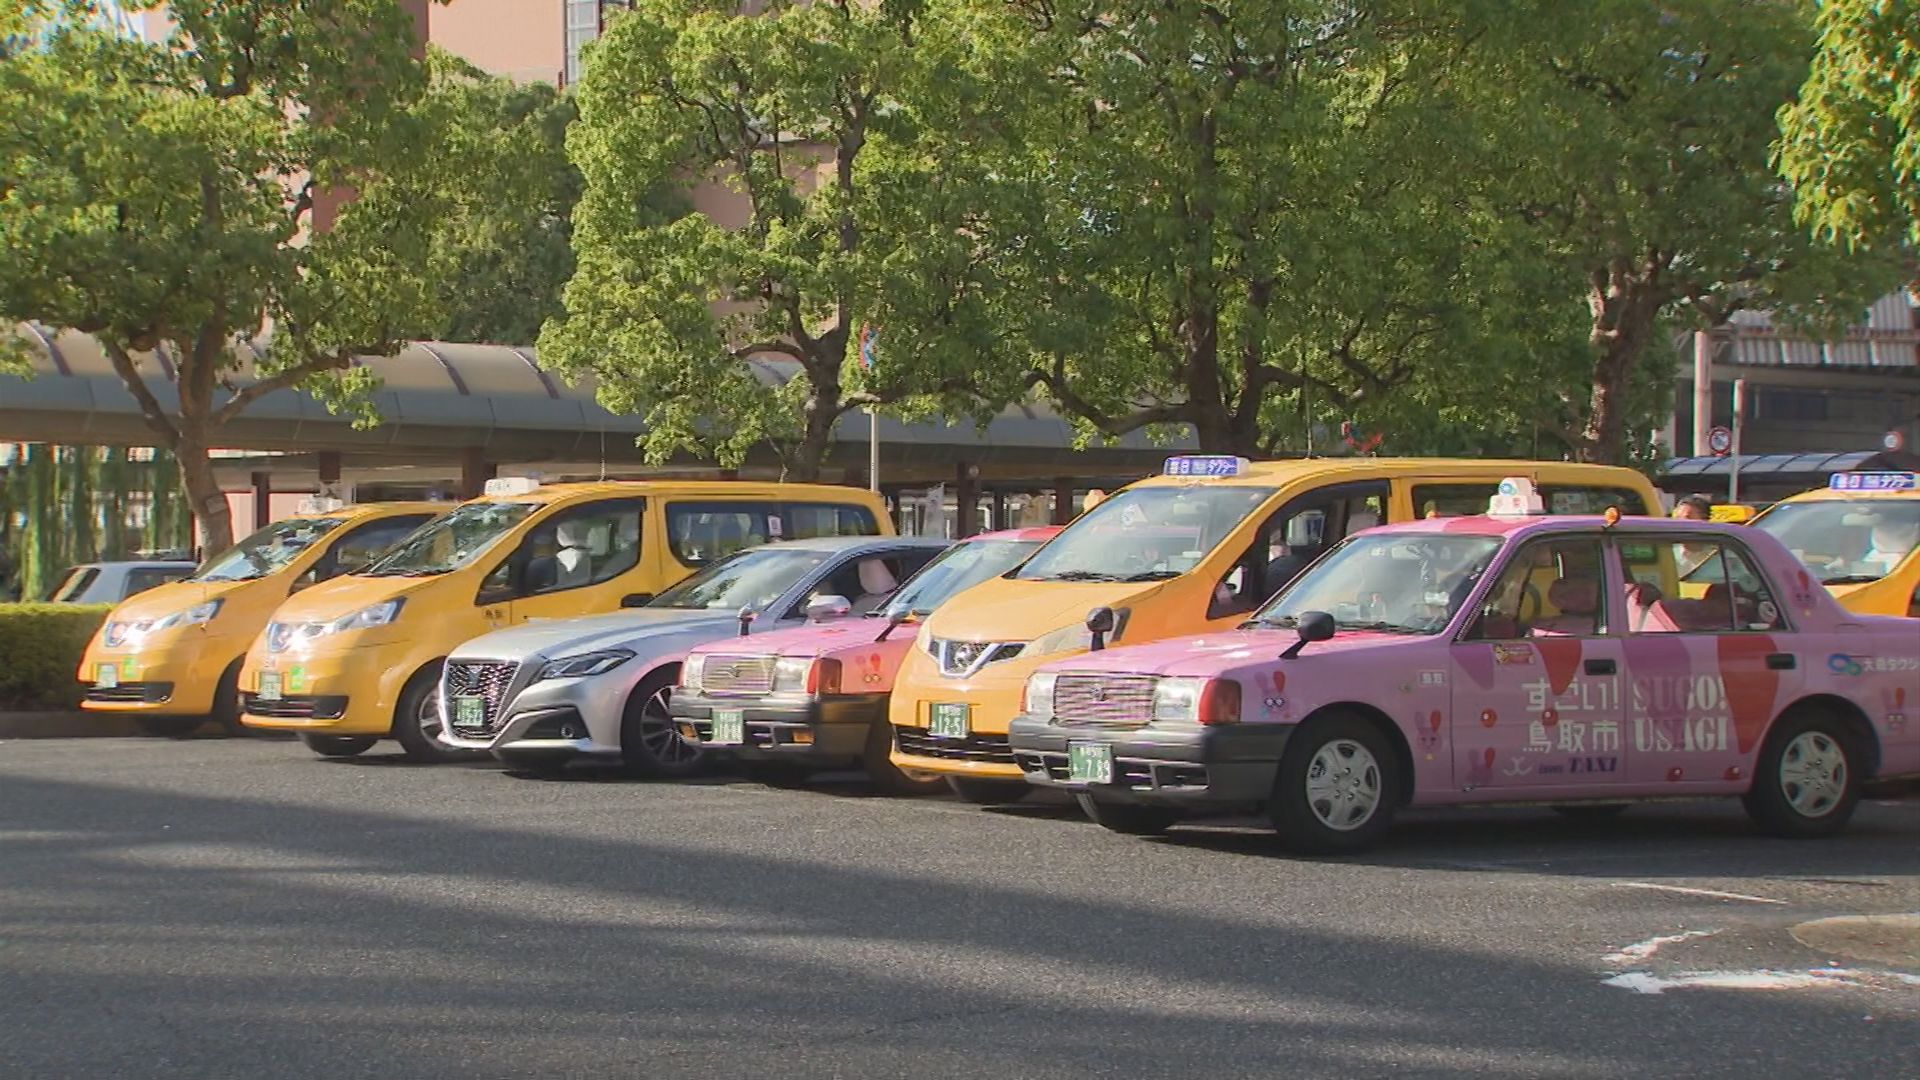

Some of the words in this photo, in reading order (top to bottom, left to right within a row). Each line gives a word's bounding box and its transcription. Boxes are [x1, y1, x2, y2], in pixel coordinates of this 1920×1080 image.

[1632, 675, 1727, 711] SUGO!
[1521, 719, 1619, 753] 鳥取市
[1632, 717, 1728, 752] USAGI
[1568, 757, 1618, 773] TAXI
